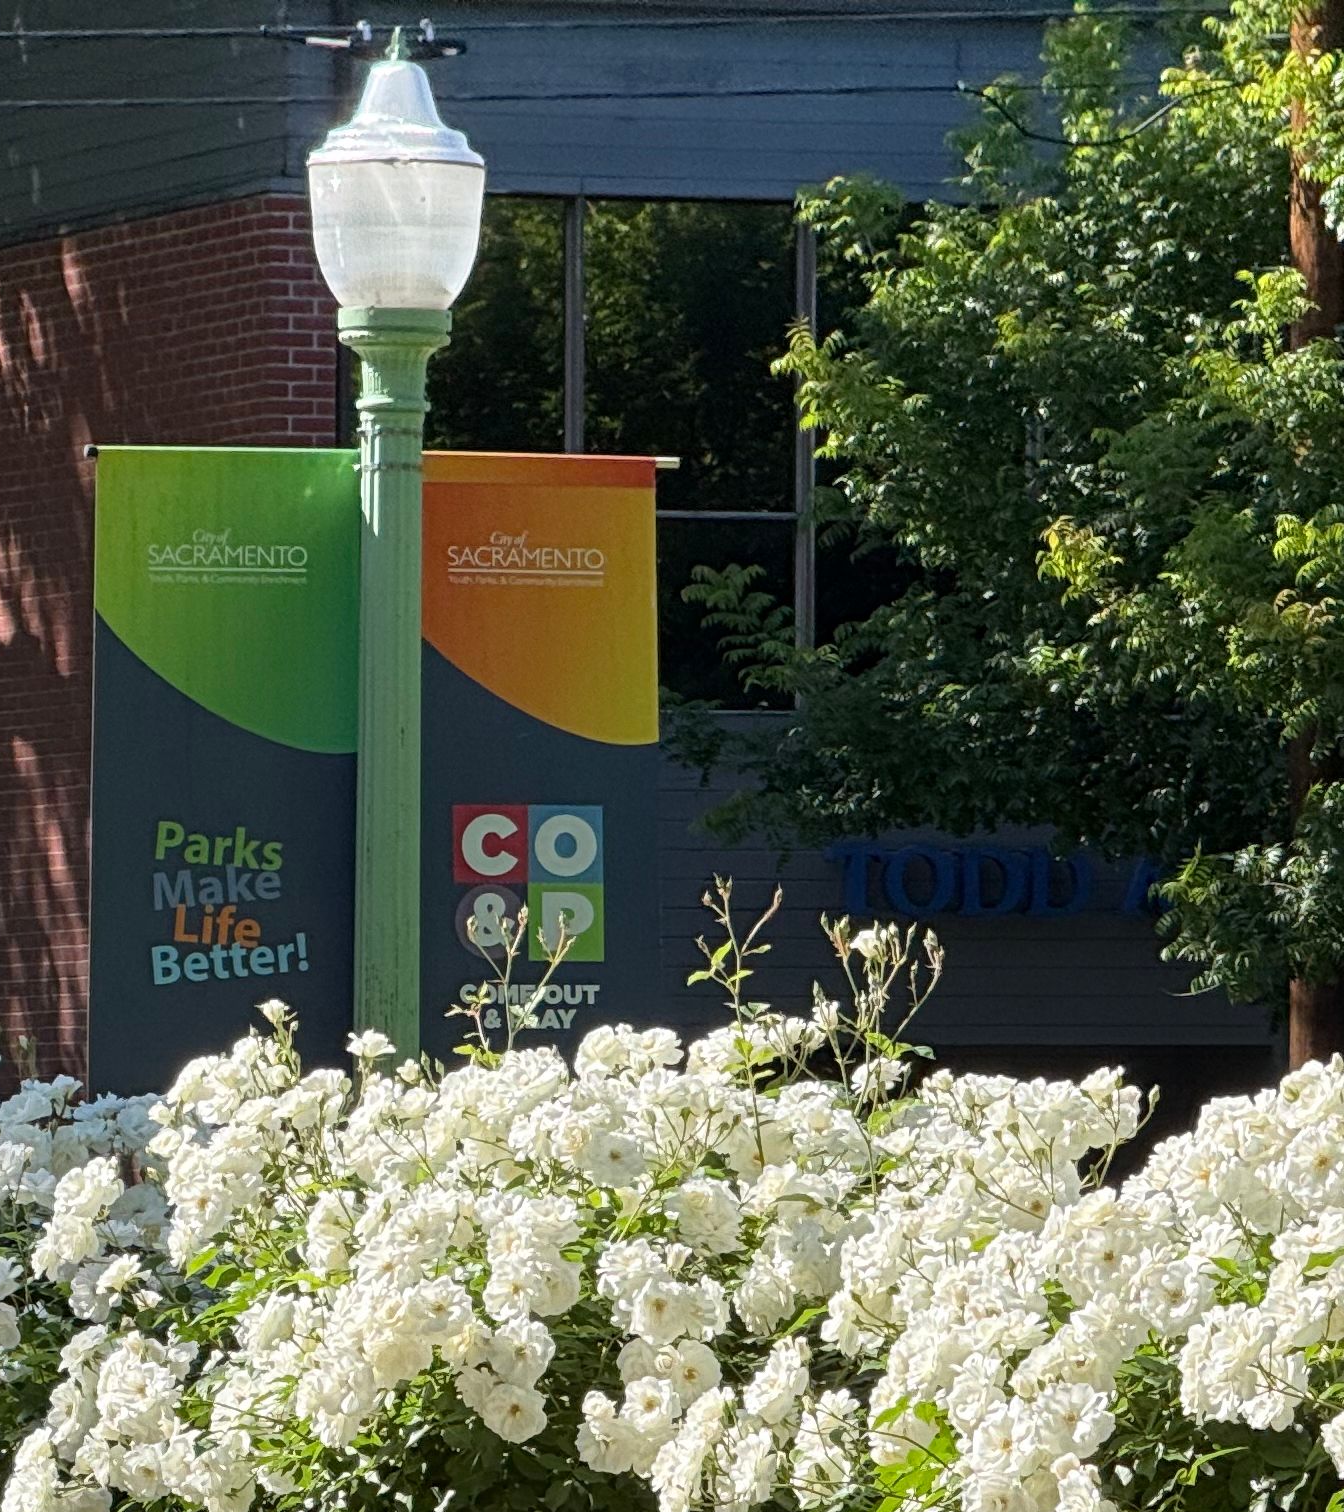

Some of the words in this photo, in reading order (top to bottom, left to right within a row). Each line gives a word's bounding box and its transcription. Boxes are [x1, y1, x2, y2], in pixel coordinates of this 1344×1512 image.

[148, 544, 308, 567] SACRAMENTO
[447, 546, 605, 569] SACRAMENTO
[155, 820, 284, 871] Parks
[461, 813, 598, 877] CO
[152, 864, 282, 911] Make
[822, 845, 1094, 918] TODD
[173, 904, 262, 948] Life
[150, 932, 309, 985] Better!
[543, 984, 601, 1005] OUT
[483, 1008, 502, 1029] &
